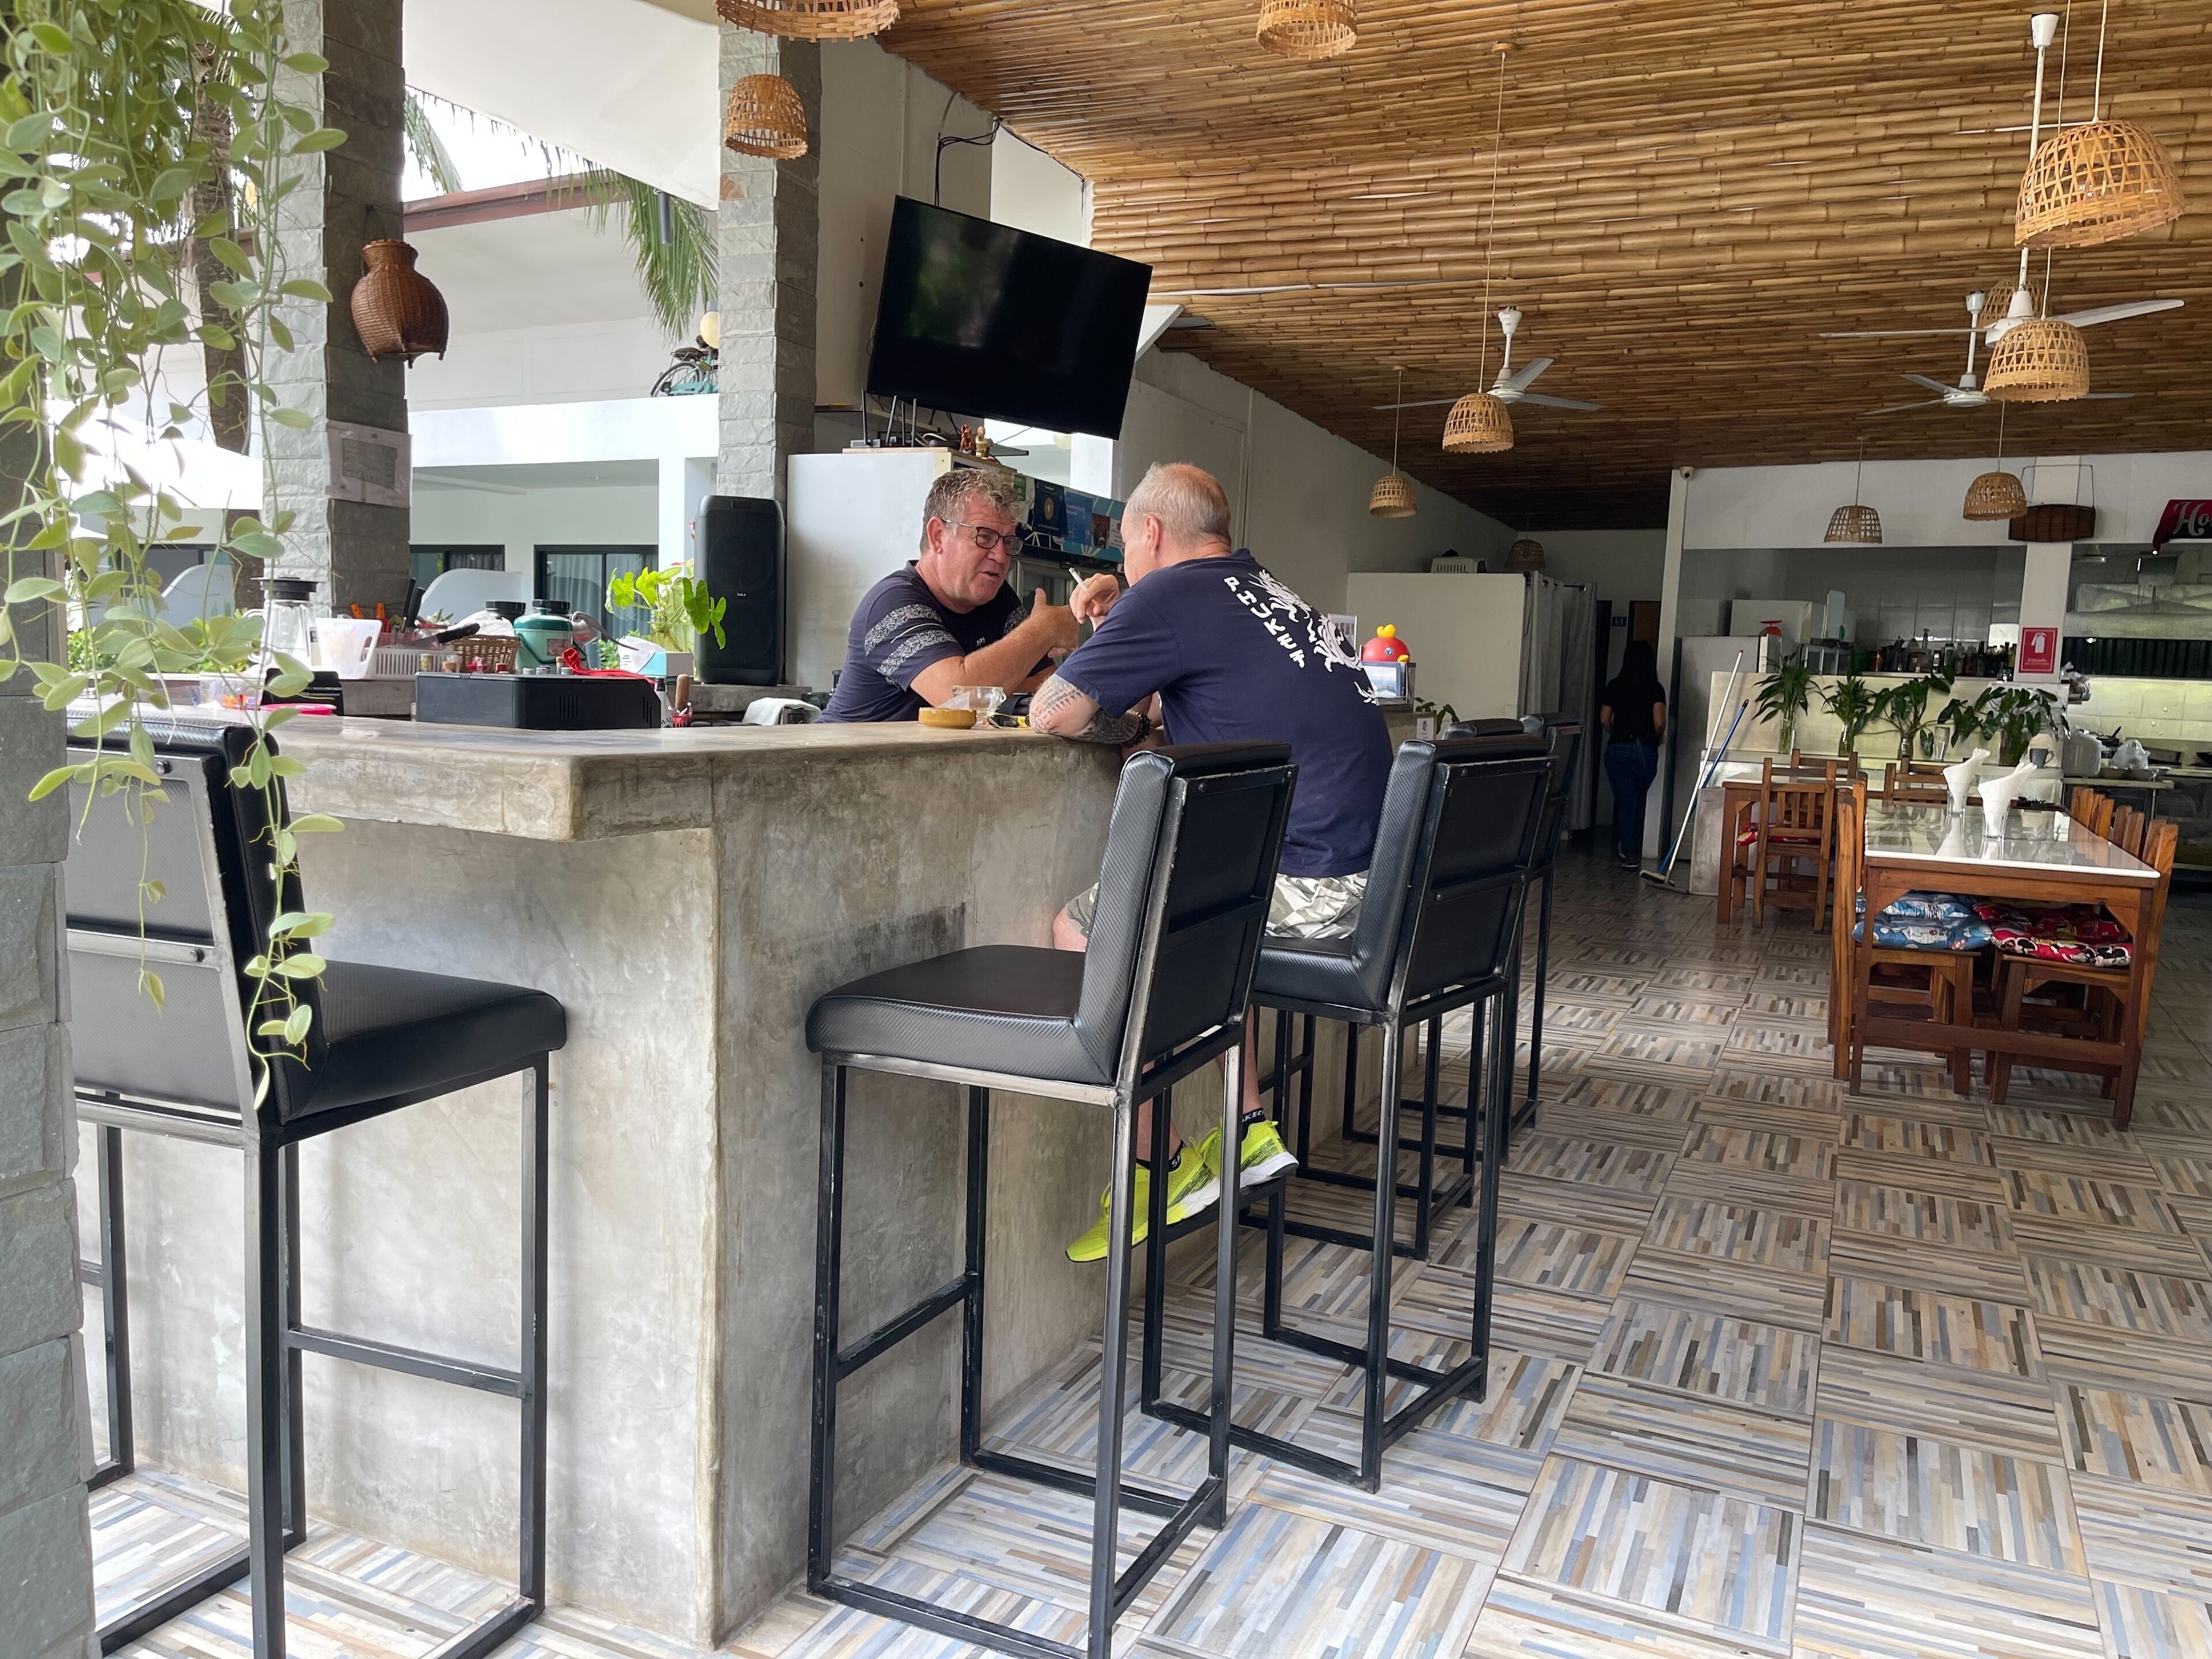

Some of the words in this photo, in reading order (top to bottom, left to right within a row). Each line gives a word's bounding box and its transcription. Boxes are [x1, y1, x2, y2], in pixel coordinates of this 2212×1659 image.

[2172, 501, 2212, 536] Ho
[1223, 576, 1305, 668] PHUKET
[1242, 1109, 1264, 1123] KEC
